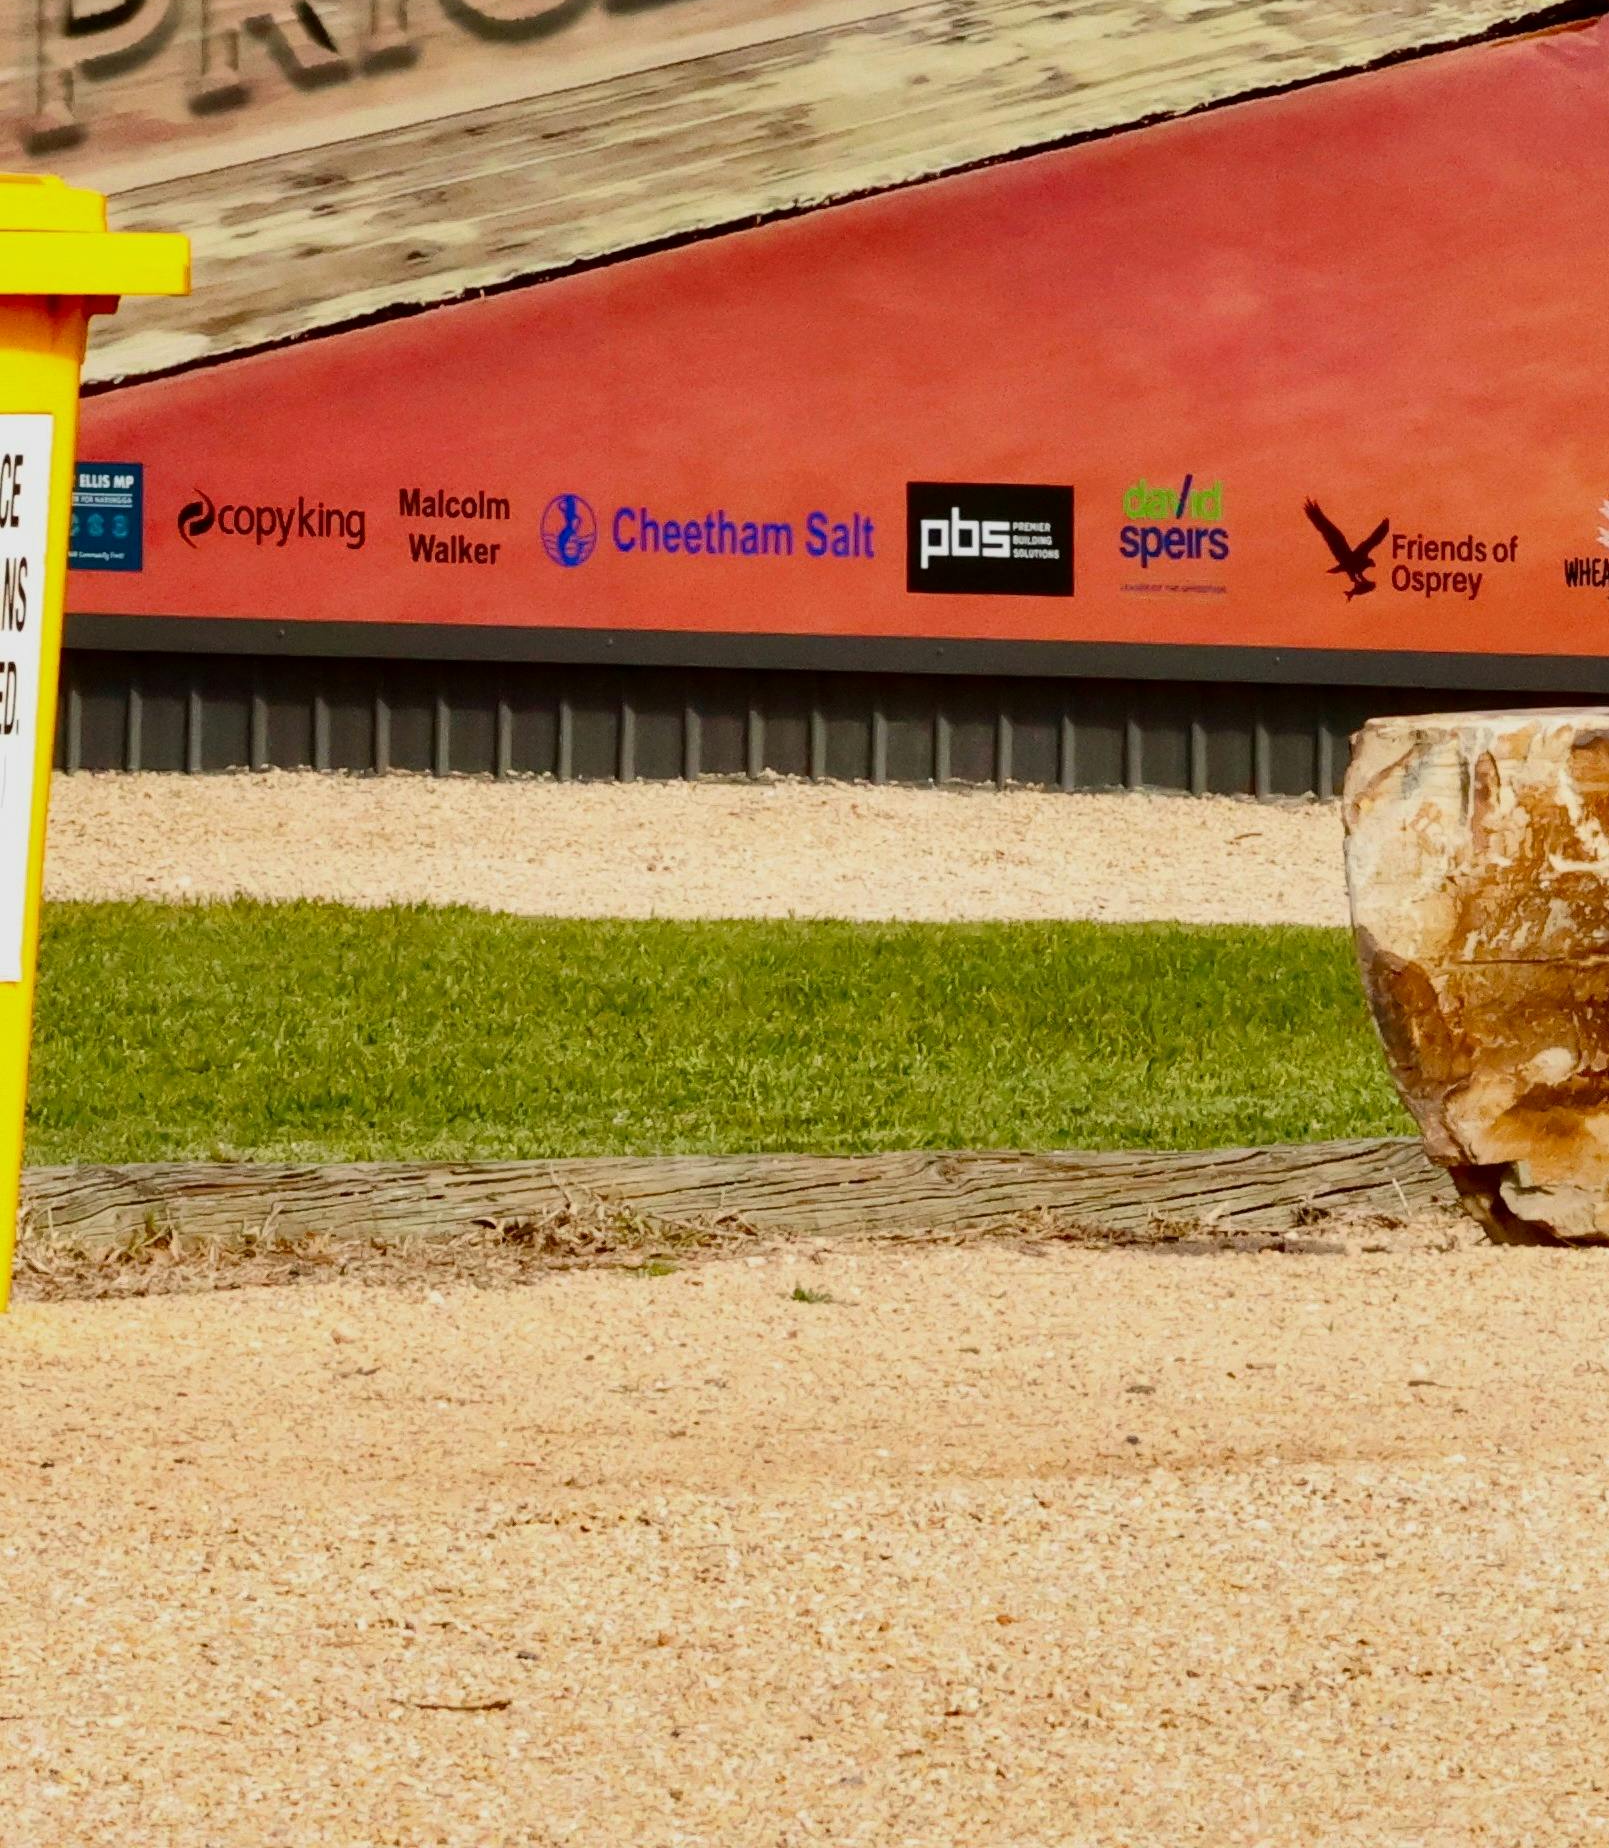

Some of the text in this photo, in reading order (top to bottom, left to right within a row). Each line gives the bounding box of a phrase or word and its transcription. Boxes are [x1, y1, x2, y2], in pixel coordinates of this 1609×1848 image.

[79, 474, 135, 489] ELLIS MP
[399, 488, 510, 520] Malcolm
[218, 496, 365, 549] copyking
[612, 507, 875, 559] Cheetham Salt
[920, 506, 1011, 569] pbs
[408, 532, 500, 565] Walker
[1119, 524, 1230, 569] speirs
[1392, 533, 1518, 563] Friends of
[1391, 564, 1483, 600] Osprey
